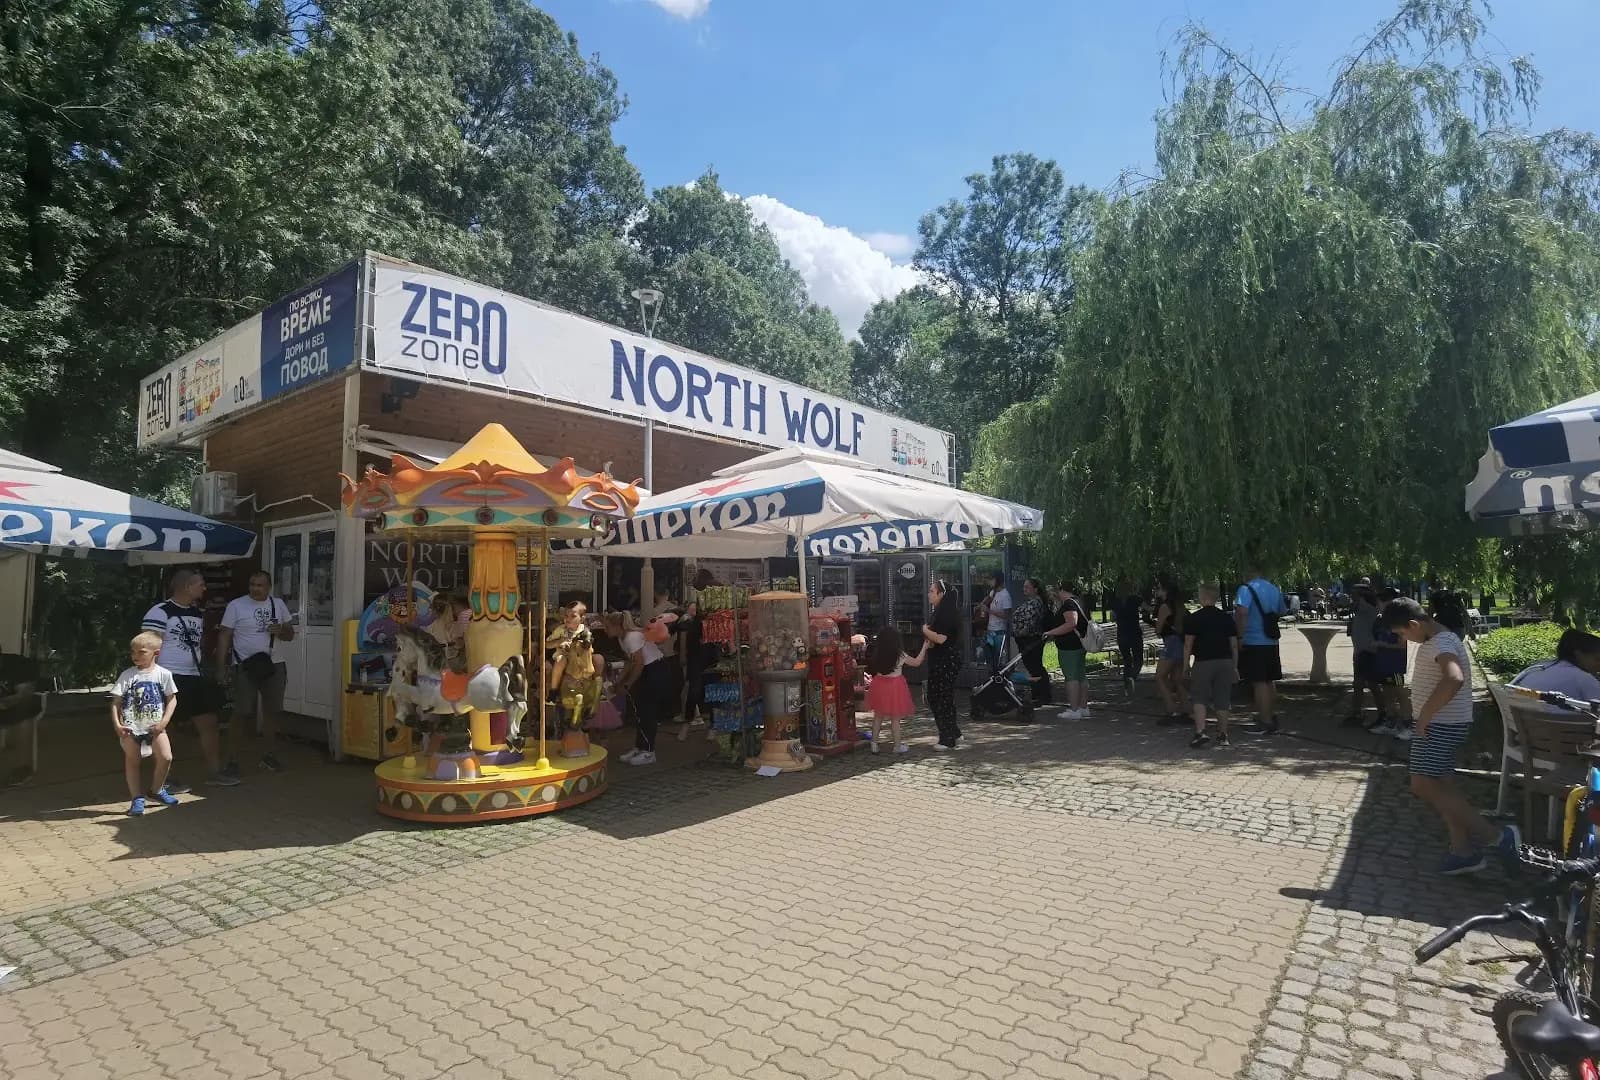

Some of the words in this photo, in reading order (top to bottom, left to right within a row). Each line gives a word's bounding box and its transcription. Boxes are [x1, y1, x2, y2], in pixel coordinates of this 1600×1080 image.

[281, 295, 331, 342] ВРЕМЕ
[289, 300, 299, 313] ПО
[300, 288, 322, 307] ВСЯКО
[285, 341, 304, 361] ДОРИ
[305, 340, 311, 351] И
[311, 332, 325, 348] БЕЗ
[401, 281, 507, 374] ZERO
[281, 347, 329, 386] ПОВОД
[401, 335, 479, 369] zone
[146, 372, 171, 429] ZERO
[611, 339, 767, 435] NORTH
[780, 391, 866, 455] WOLF
[146, 416, 165, 437] zone
